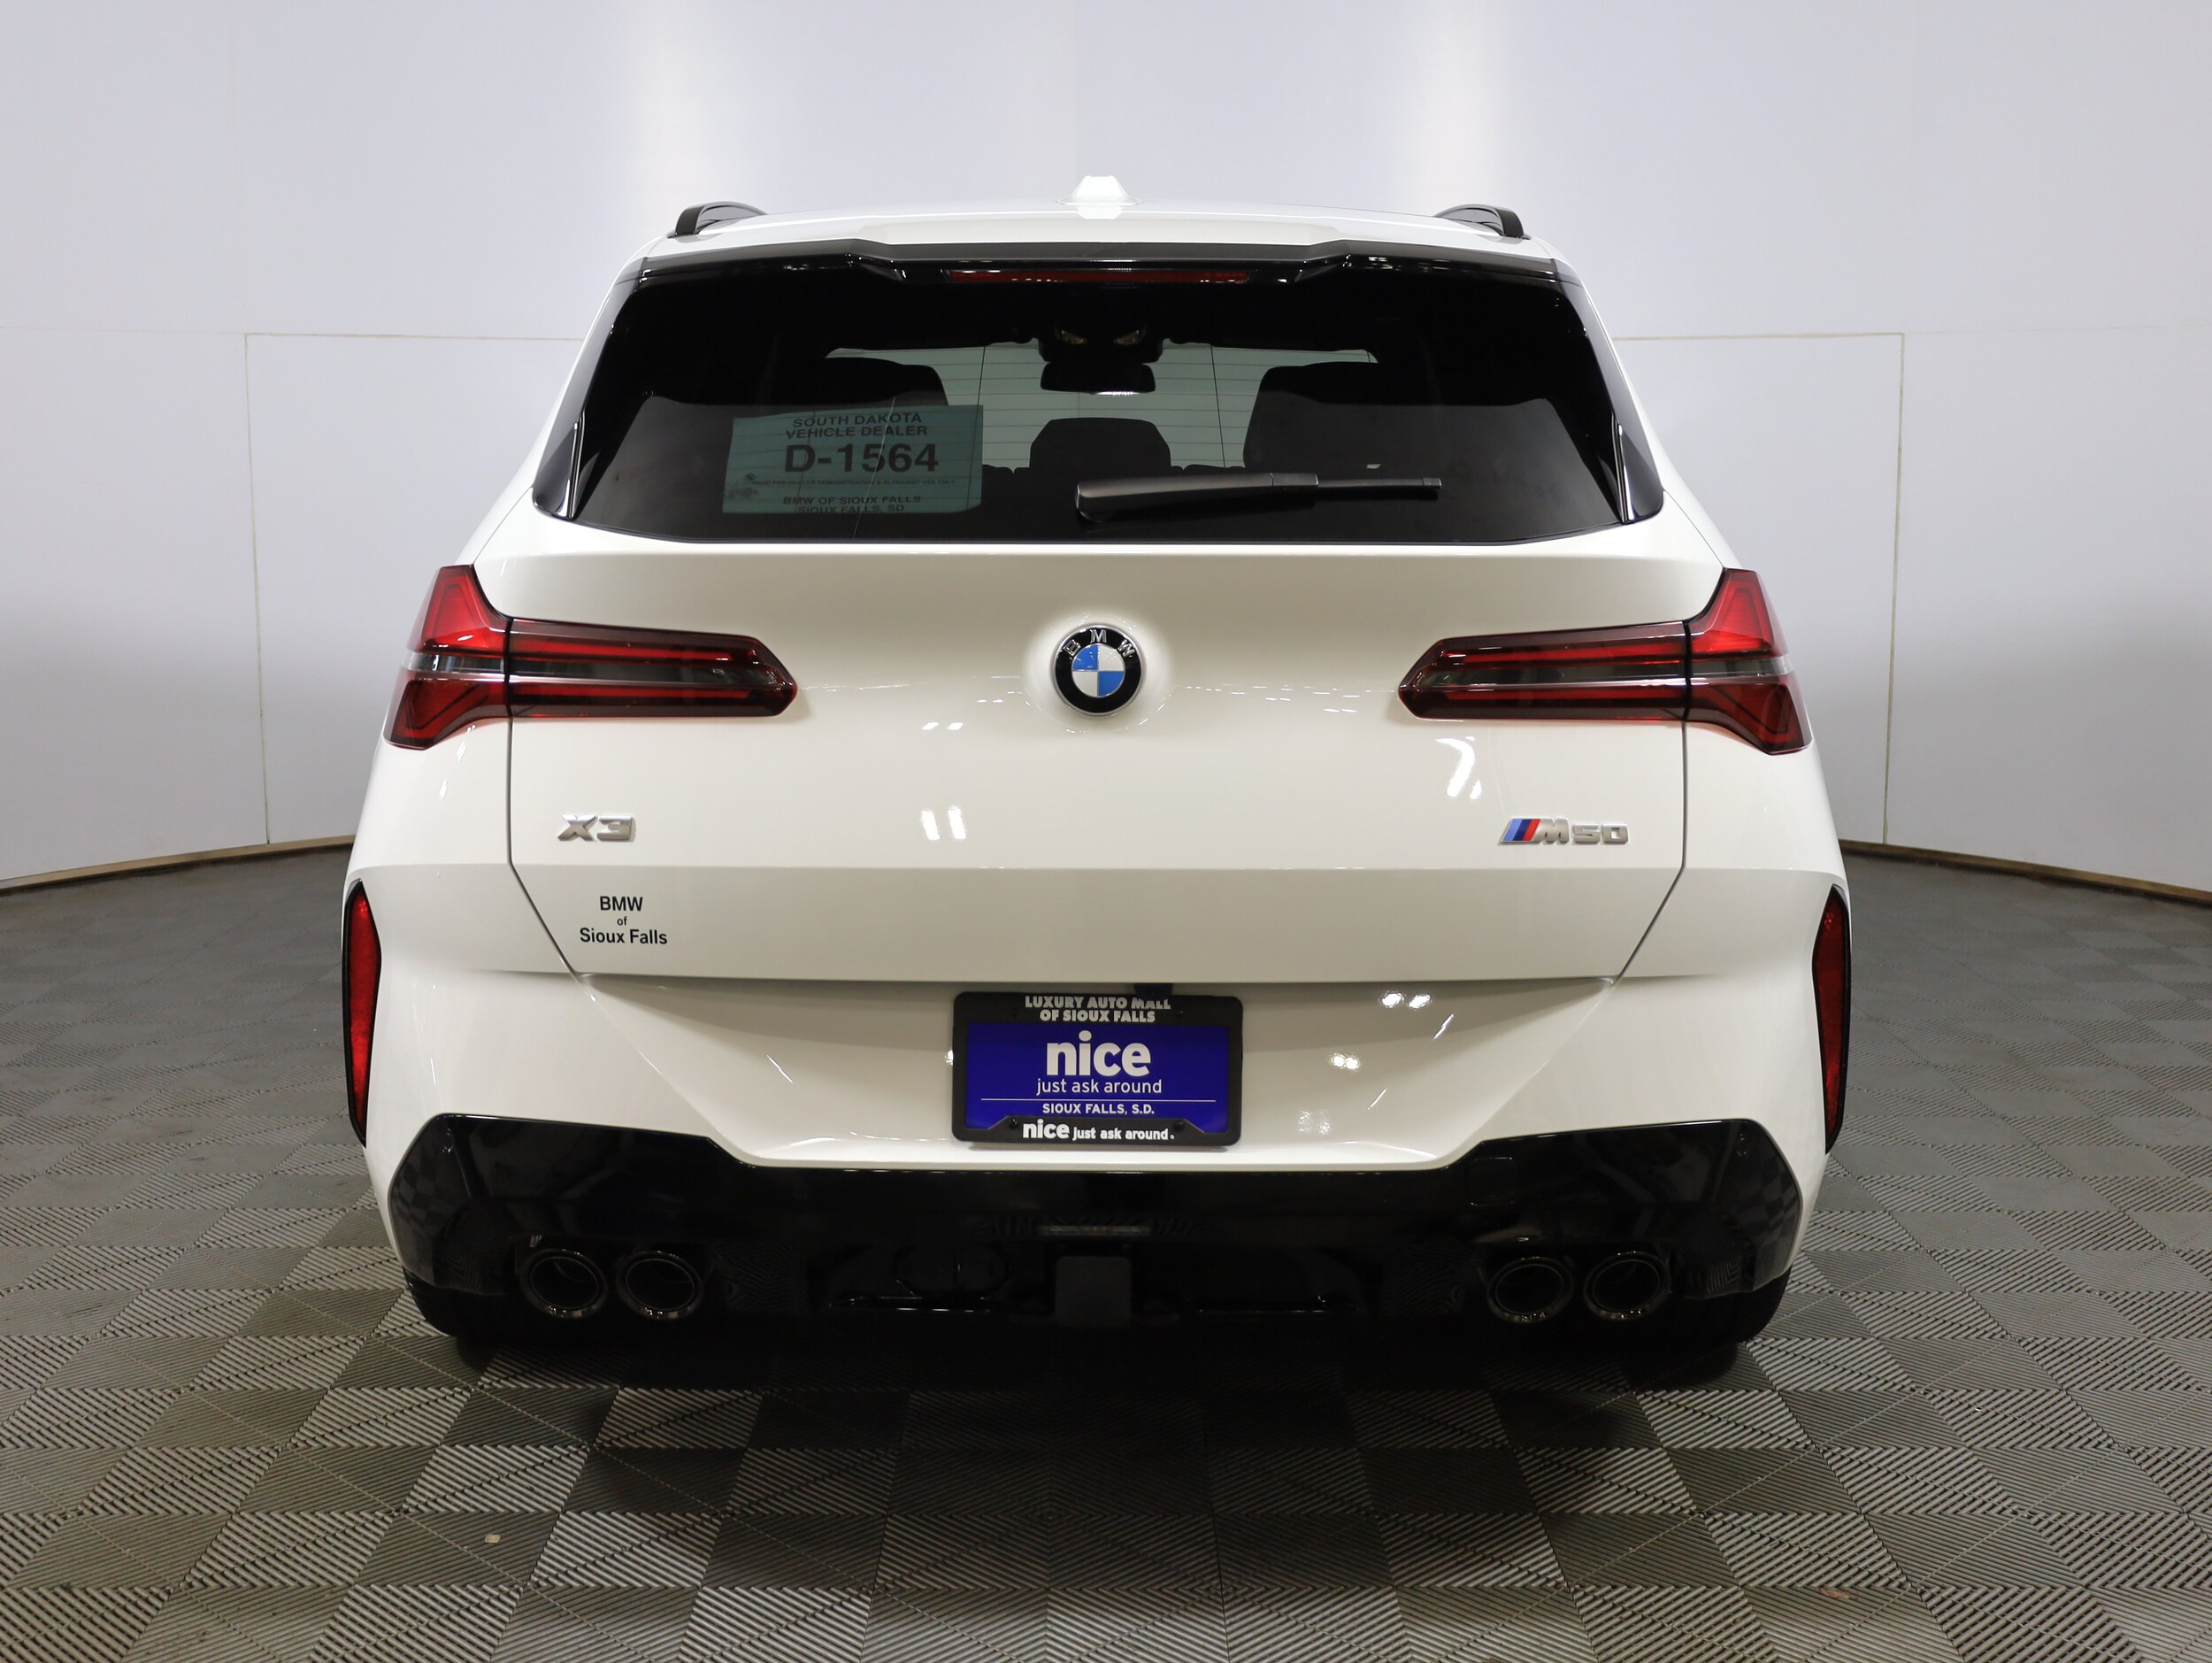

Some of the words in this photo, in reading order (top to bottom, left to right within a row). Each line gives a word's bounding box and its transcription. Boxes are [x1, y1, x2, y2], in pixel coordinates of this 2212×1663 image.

[793, 416, 849, 427] SOUTH
[854, 413, 922, 425] DAKOTA
[786, 427, 856, 439] VEHICLE
[861, 426, 927, 436] DEALER
[785, 443, 938, 473] D-1564
[799, 505, 835, 514] SIOUX
[1064, 629, 1135, 658] BMW
[557, 814, 635, 842] X3
[1530, 819, 1628, 843] M50
[600, 896, 643, 911] BMW
[617, 916, 627, 926] of
[580, 928, 625, 943] Sioux
[630, 929, 667, 944] Falls
[1025, 997, 1083, 1008] LUXURY
[1087, 997, 1126, 1009] AUTO
[1132, 998, 1171, 1010] MALL
[1040, 1010, 1059, 1021] OF
[1063, 1011, 1110, 1022] SIOUX
[1114, 1011, 1156, 1022] FALLS
[1047, 1030, 1151, 1076] nice
[1036, 1078, 1067, 1096] just
[1071, 1079, 1099, 1093] ask
[1104, 1080, 1162, 1094] around
[1042, 1104, 1081, 1113] SIOUX
[1086, 1105, 1128, 1115] FALLS,
[1132, 1105, 1155, 1114] S.D.
[1023, 1119, 1070, 1139] nice
[1072, 1126, 1096, 1141] just
[1101, 1127, 1123, 1140] ask
